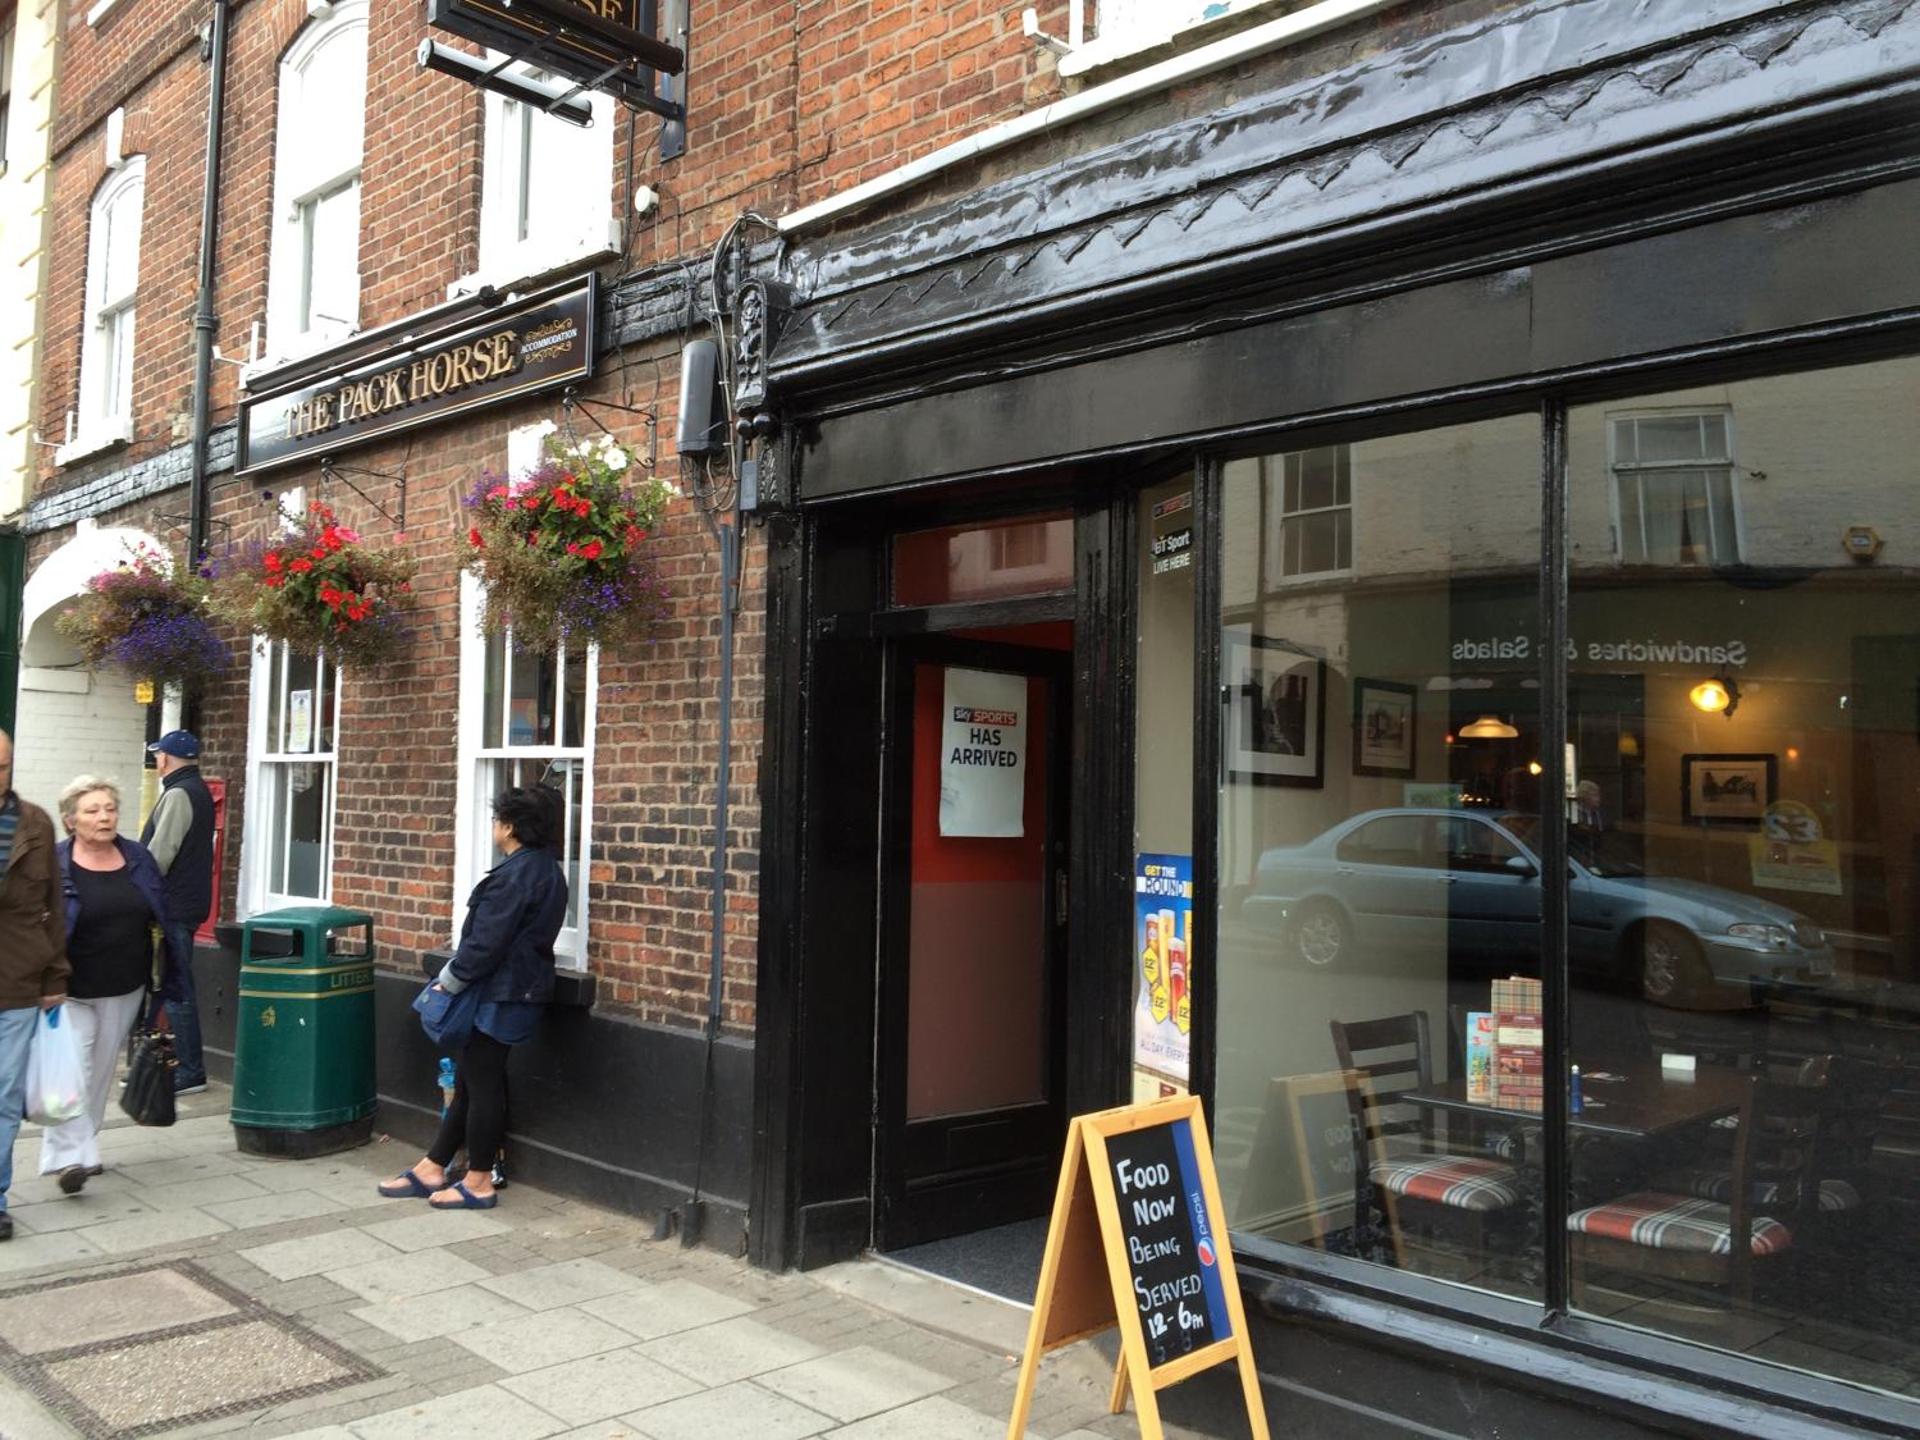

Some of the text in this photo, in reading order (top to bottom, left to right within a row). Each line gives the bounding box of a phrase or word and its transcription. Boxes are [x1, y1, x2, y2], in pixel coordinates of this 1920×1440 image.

[520, 327, 578, 354] ACCOMMODATION
[283, 330, 517, 440] THE PACK HORSE
[1155, 531, 1190, 554] BT Sport
[973, 710, 1017, 725] SPORTS
[970, 728, 1001, 745] HAS
[951, 747, 1017, 768] ARRIVED
[1116, 1158, 1170, 1194] FOOD
[1133, 1196, 1176, 1226] NOW
[1191, 1192, 1209, 1235] pepsi
[1129, 1236, 1182, 1265] BEING
[1134, 1274, 1202, 1312] SERVED
